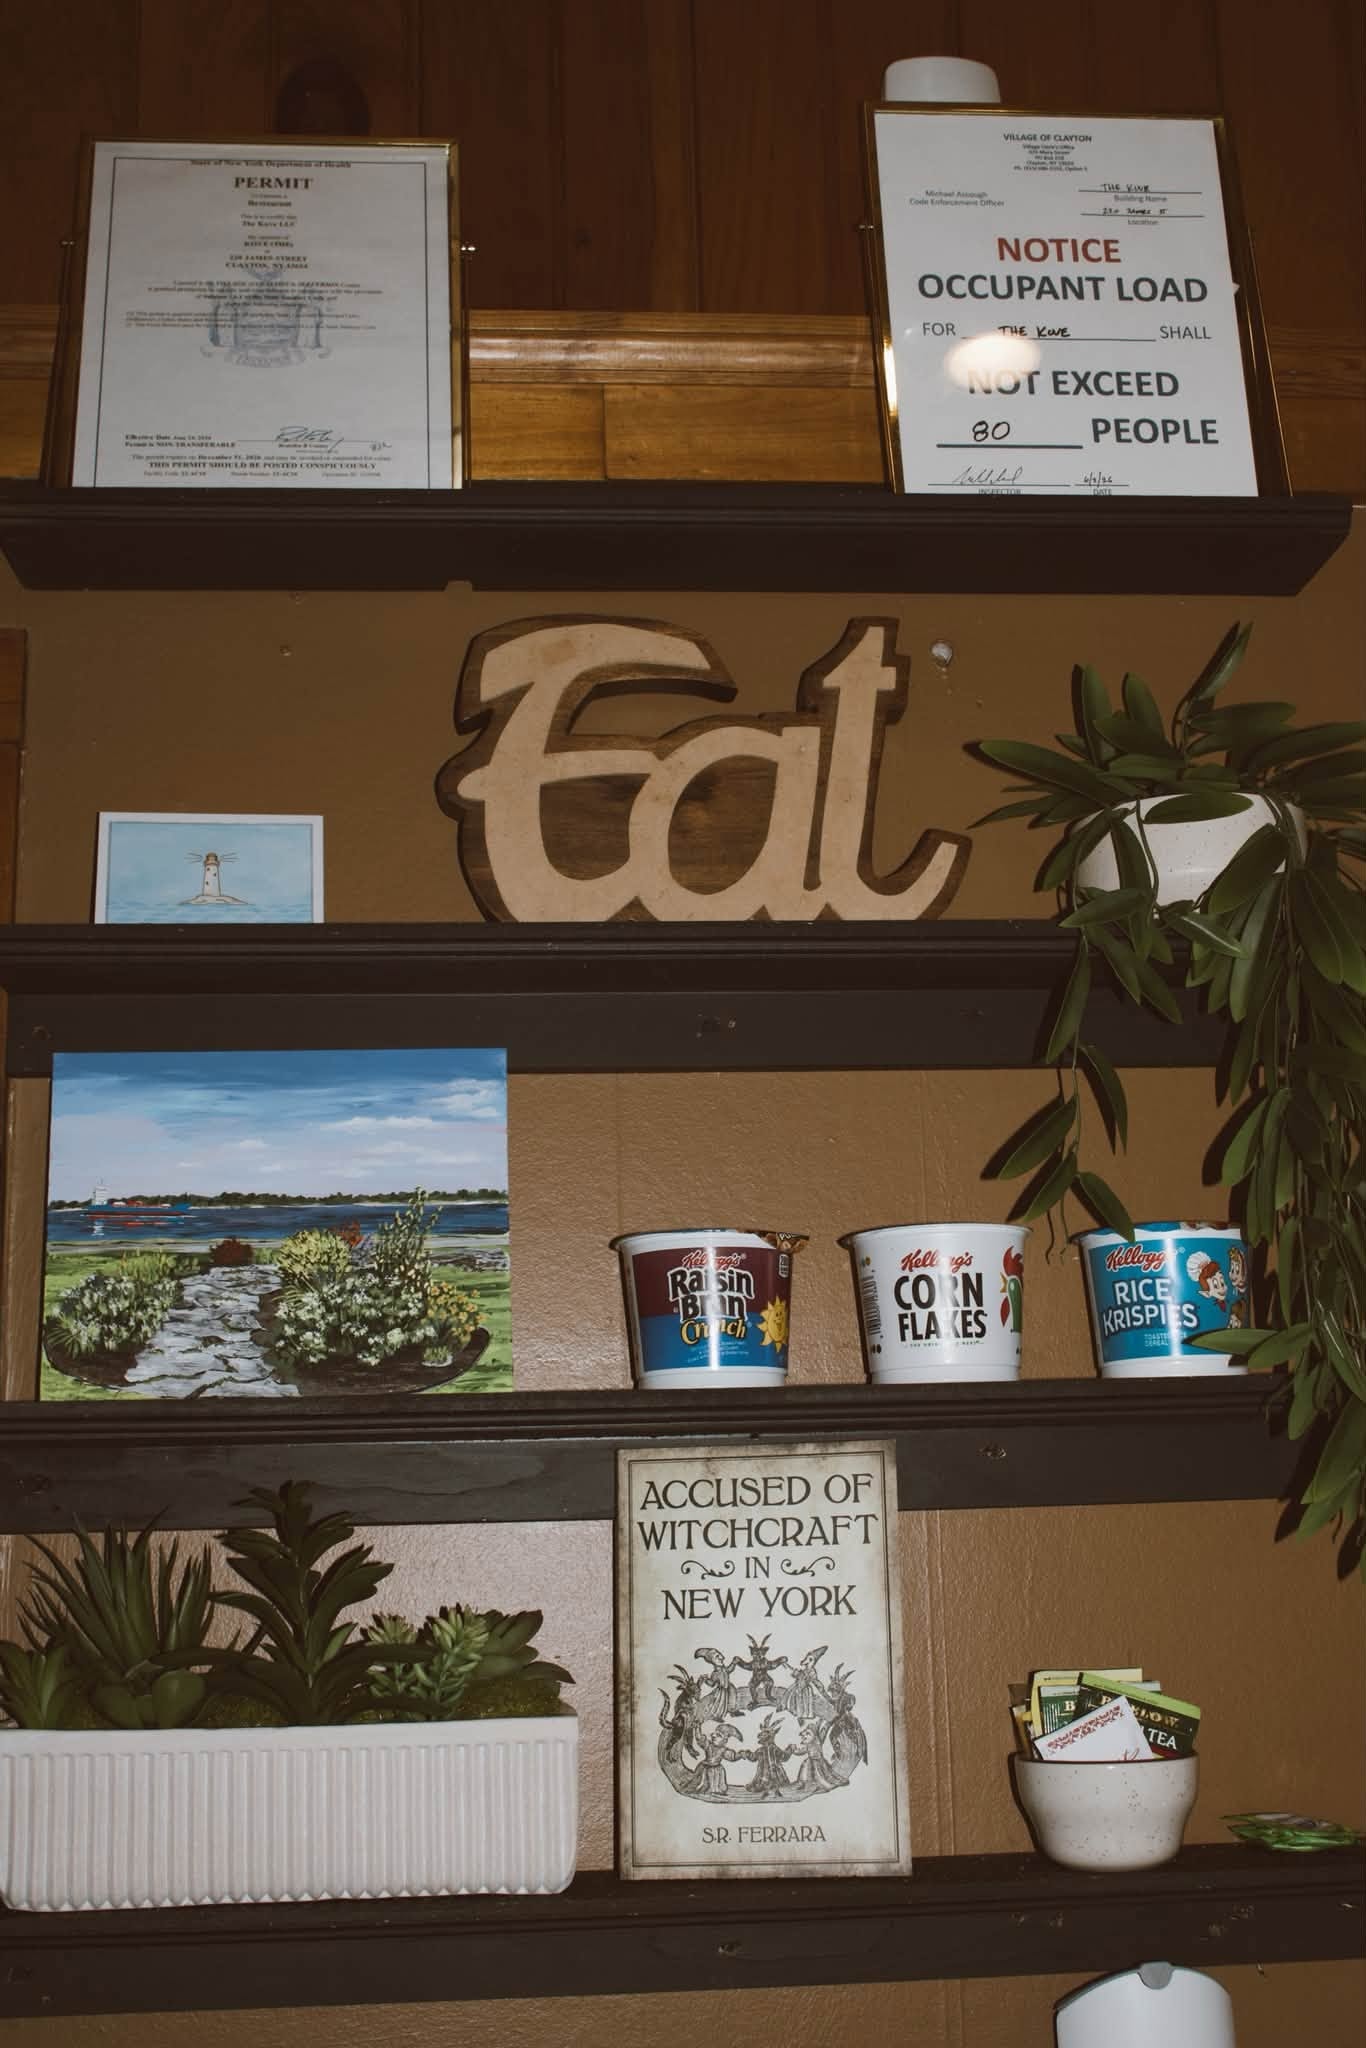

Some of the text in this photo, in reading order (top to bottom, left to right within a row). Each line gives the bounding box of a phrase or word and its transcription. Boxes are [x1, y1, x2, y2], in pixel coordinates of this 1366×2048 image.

[1003, 133, 1092, 143] VILLAGE OF CLAYTON
[233, 176, 314, 190] PERMIT
[909, 198, 1005, 208] Code Enforcement Officer
[996, 237, 1122, 264] NOTICE
[918, 273, 1208, 303] OCCUPANT LOAD
[922, 321, 957, 337] FOR
[997, 324, 1028, 337] THE
[1160, 324, 1213, 340] SHALL
[967, 369, 1180, 397] NOT EXCEED
[972, 420, 1011, 442] 80
[1091, 417, 1221, 445] PEOPLE
[457, 620, 959, 921] Eat
[901, 1247, 974, 1274] Kellg's
[1105, 1243, 1178, 1273] Kellogg
[893, 1271, 985, 1311] CORN
[1113, 1277, 1172, 1306] RICE
[679, 1294, 748, 1322] Bn
[1102, 1302, 1199, 1338] KRISPIES
[681, 1318, 747, 1345] Crch
[639, 1472, 875, 1511] ACCUSED OF
[636, 1513, 880, 1552] WITCHCRAFT
[744, 1556, 771, 1580] IN
[660, 1584, 858, 1621] NEW YORK
[1147, 1727, 1178, 1750] TEA
[738, 1825, 827, 1844] FERRARA
